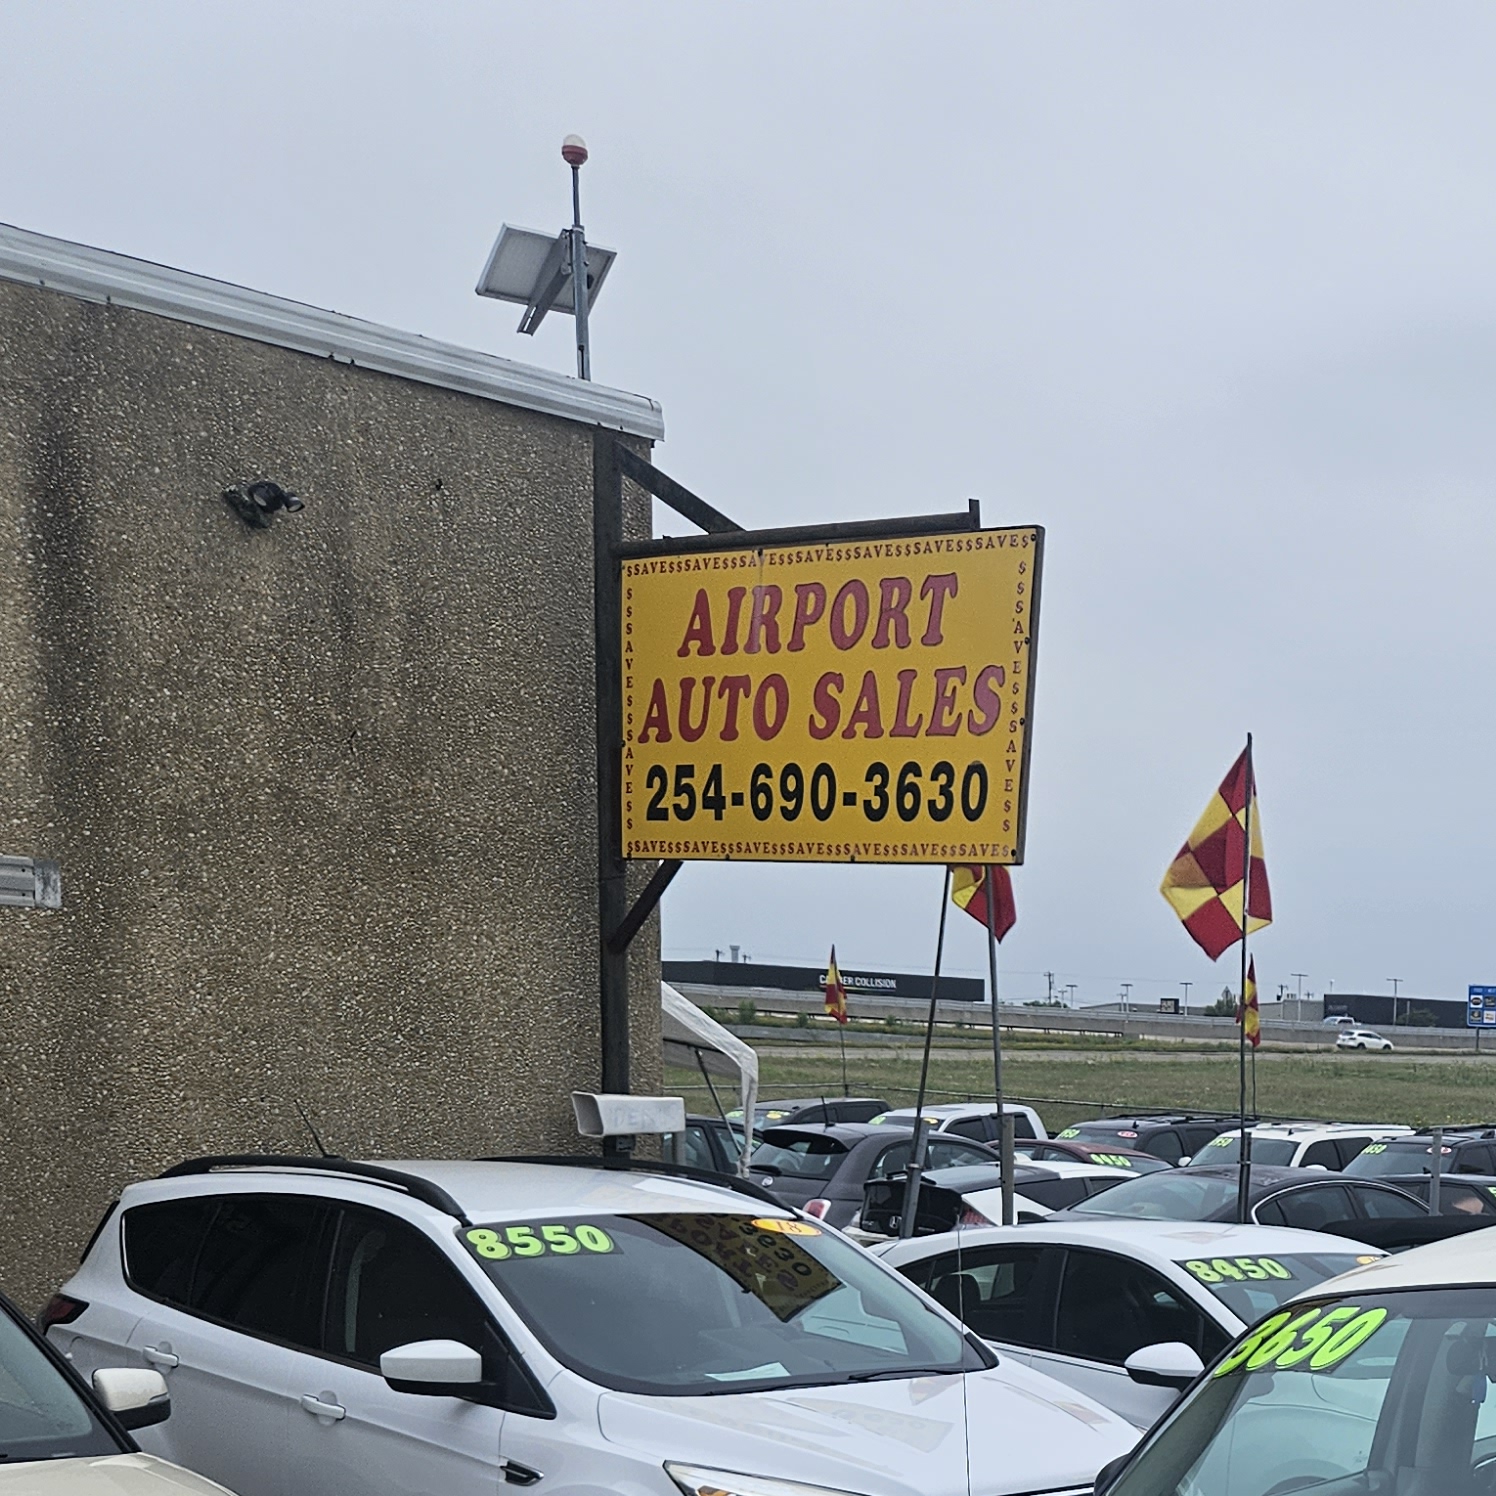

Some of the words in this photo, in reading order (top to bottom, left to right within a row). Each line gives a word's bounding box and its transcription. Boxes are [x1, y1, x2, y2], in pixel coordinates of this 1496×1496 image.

[677, 573, 958, 657] AIRPORT
[637, 673, 790, 743] AUTO
[808, 664, 1006, 740] SALES
[645, 761, 988, 822] 254-690-3630
[854, 978, 897, 989] COLLISION
[466, 1224, 615, 1260] 8550
[1185, 1256, 1293, 1283] 8450
